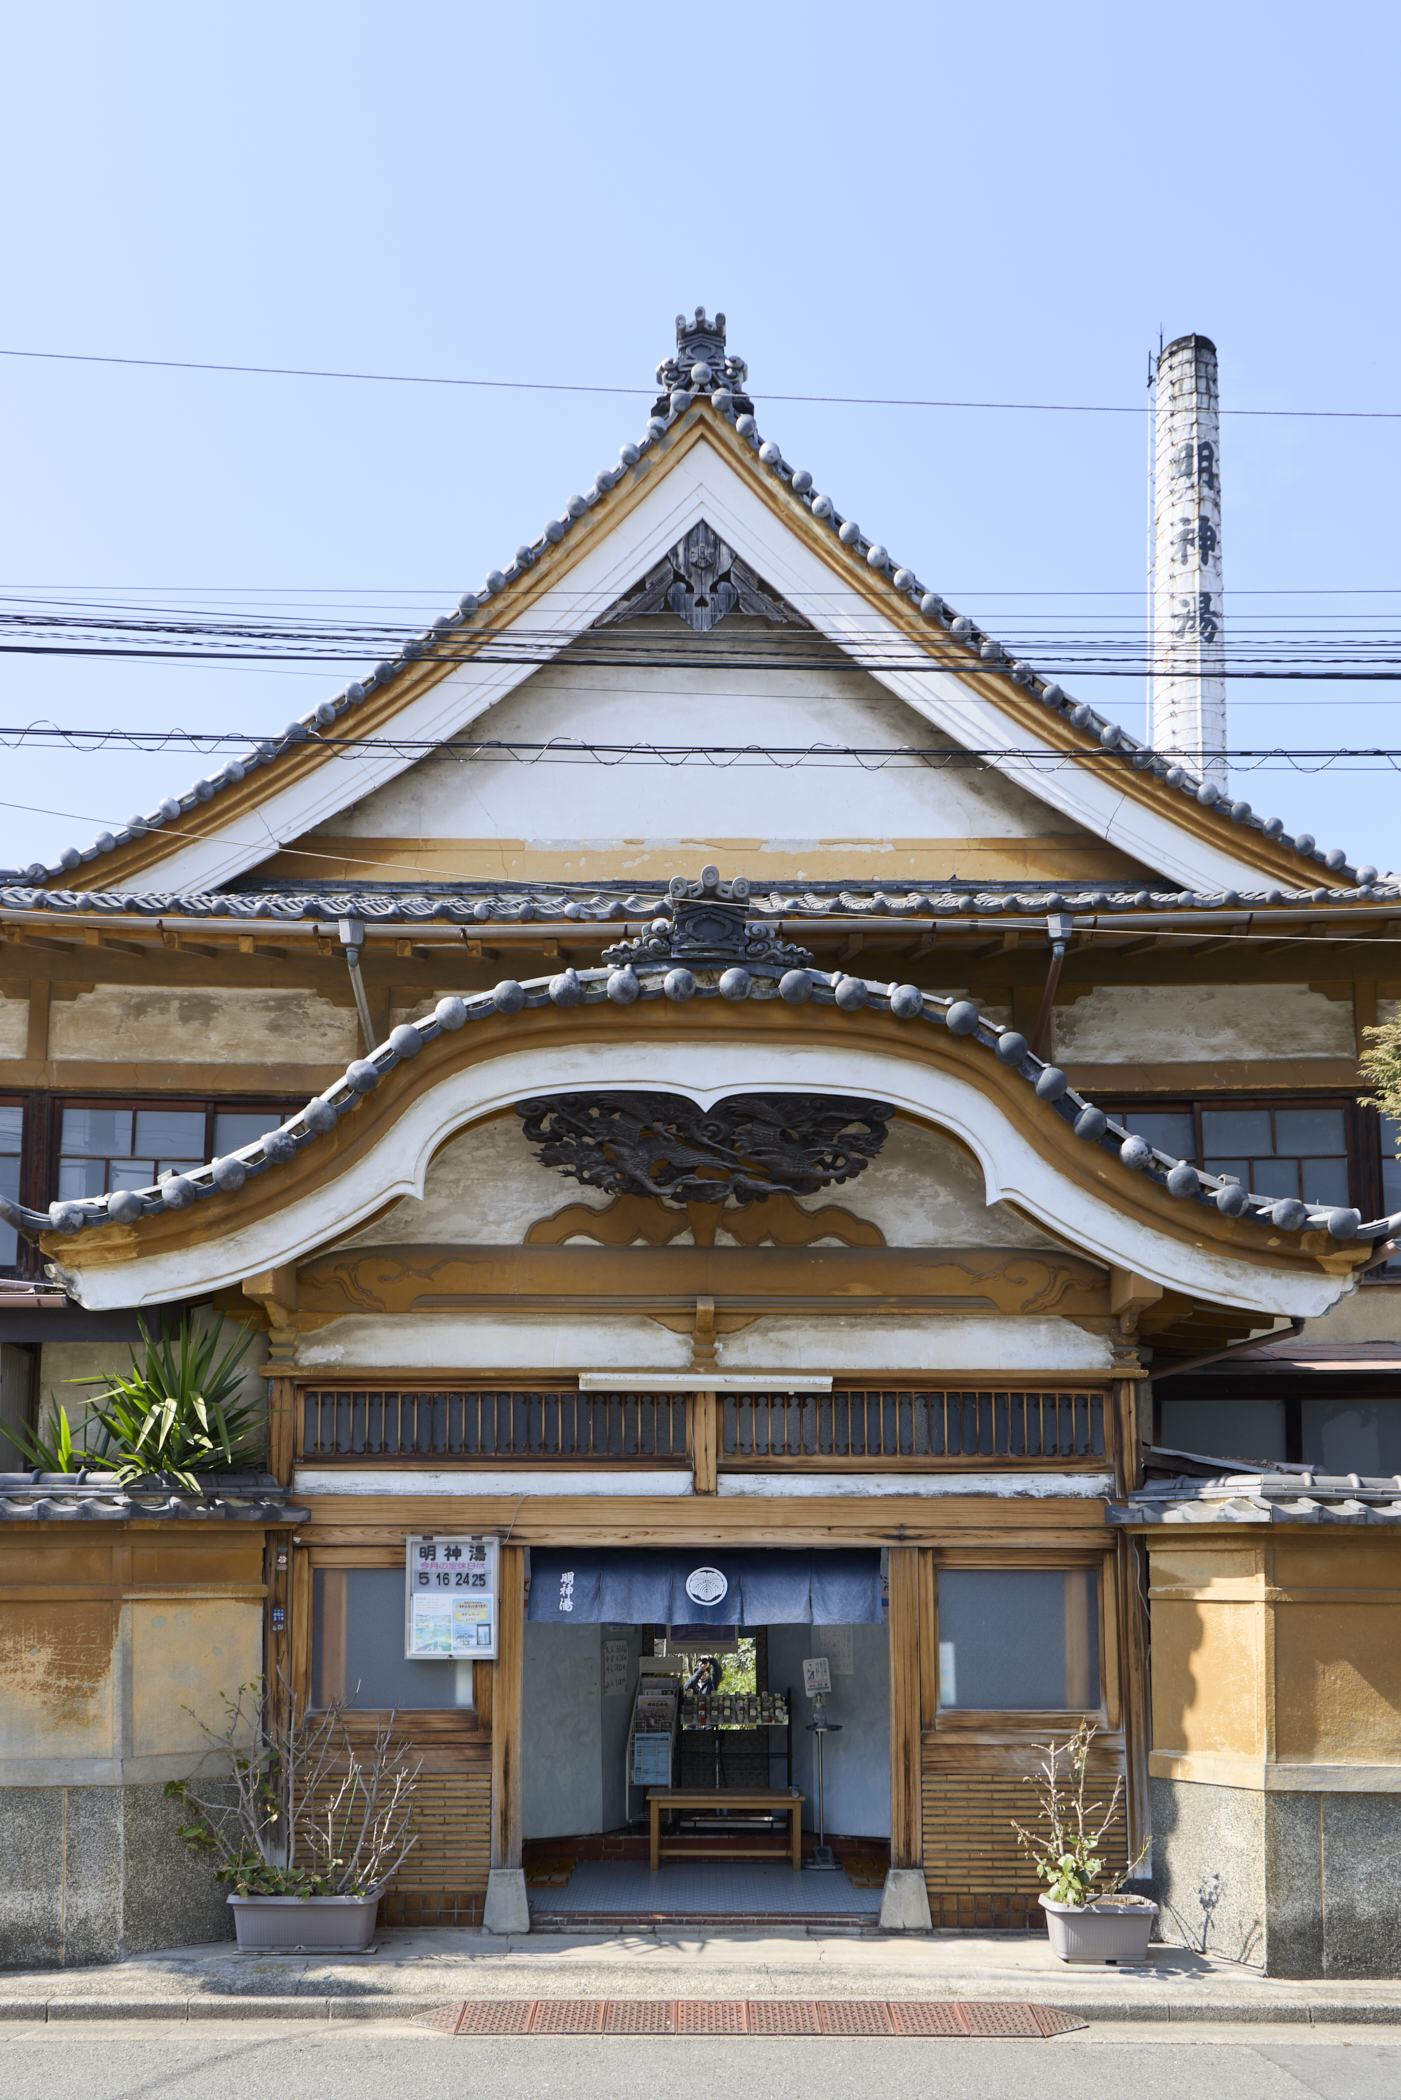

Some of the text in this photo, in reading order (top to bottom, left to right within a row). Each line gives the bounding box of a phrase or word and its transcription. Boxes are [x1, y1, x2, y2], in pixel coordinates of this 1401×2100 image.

[1172, 440, 1219, 644] 明神湯
[419, 1545, 487, 1561] 明神湯
[420, 1562, 486, 1570] 今月の定休日は
[419, 1572, 486, 1587] 5 16 24 25
[559, 1571, 575, 1612] 明神湯
